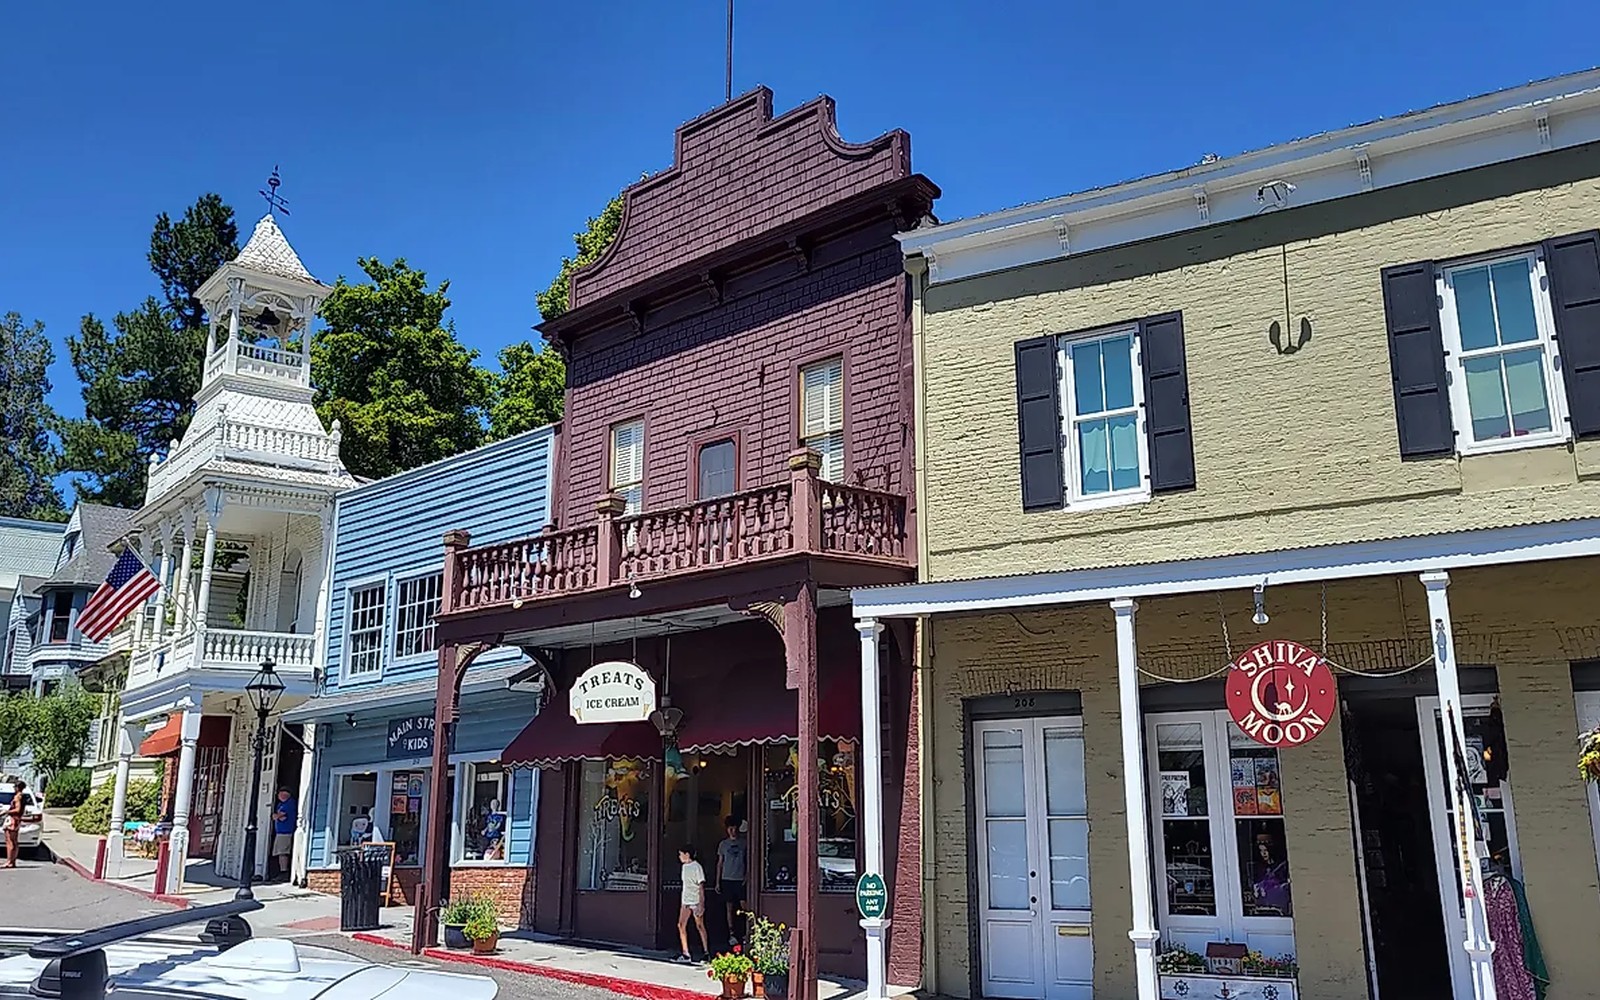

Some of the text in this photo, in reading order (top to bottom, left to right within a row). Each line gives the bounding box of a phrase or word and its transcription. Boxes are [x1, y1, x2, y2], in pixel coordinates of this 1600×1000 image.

[1239, 643, 1317, 677] SHIVA
[579, 671, 644, 694] TREATS
[586, 697, 639, 709] ICE CREAM
[389, 718, 413, 747] MAIN
[1239, 710, 1325, 743] MOON
[407, 737, 428, 750] KIDS
[594, 795, 640, 822] TREATS
